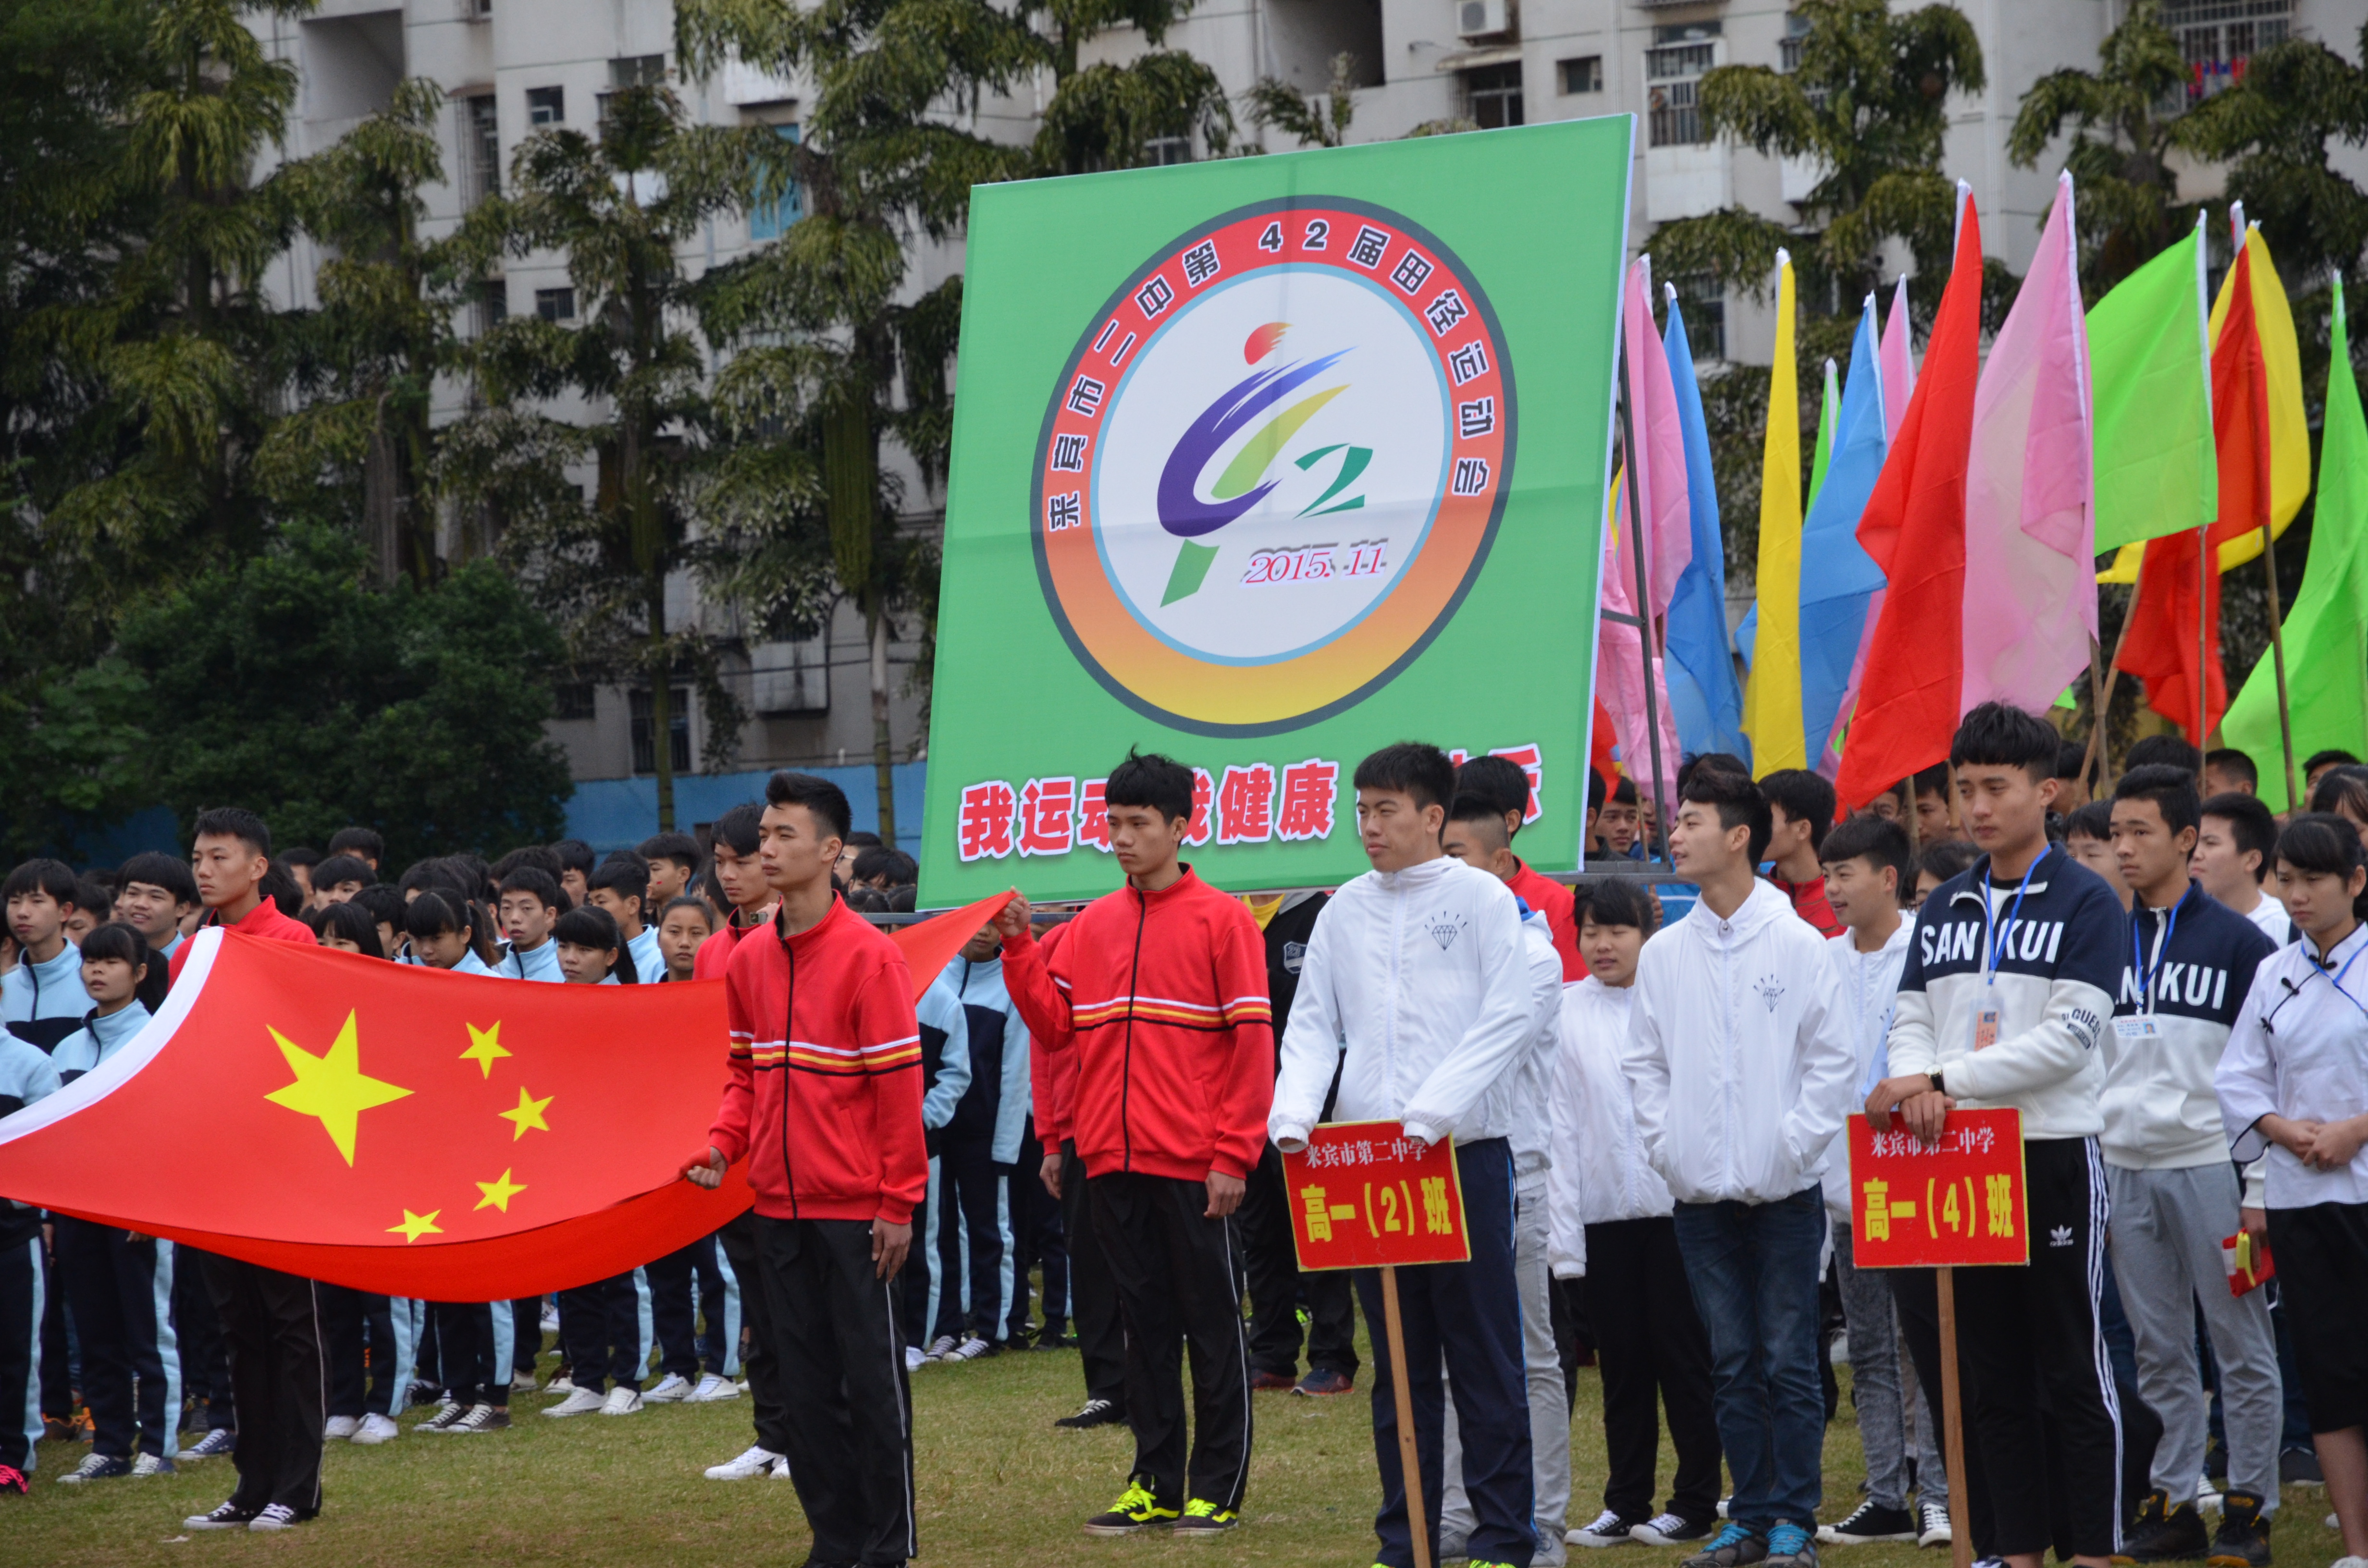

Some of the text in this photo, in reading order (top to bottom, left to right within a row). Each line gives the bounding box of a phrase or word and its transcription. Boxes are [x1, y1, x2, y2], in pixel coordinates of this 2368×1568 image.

[1921, 918, 2064, 967] SAN KUI
[2158, 962, 2227, 1009] KUI
[1305, 1137, 1427, 1169] 来宾市第二中学
[1300, 1176, 1453, 1243] 高一(2)班
[1863, 1173, 2014, 1242] 高一(4)班
